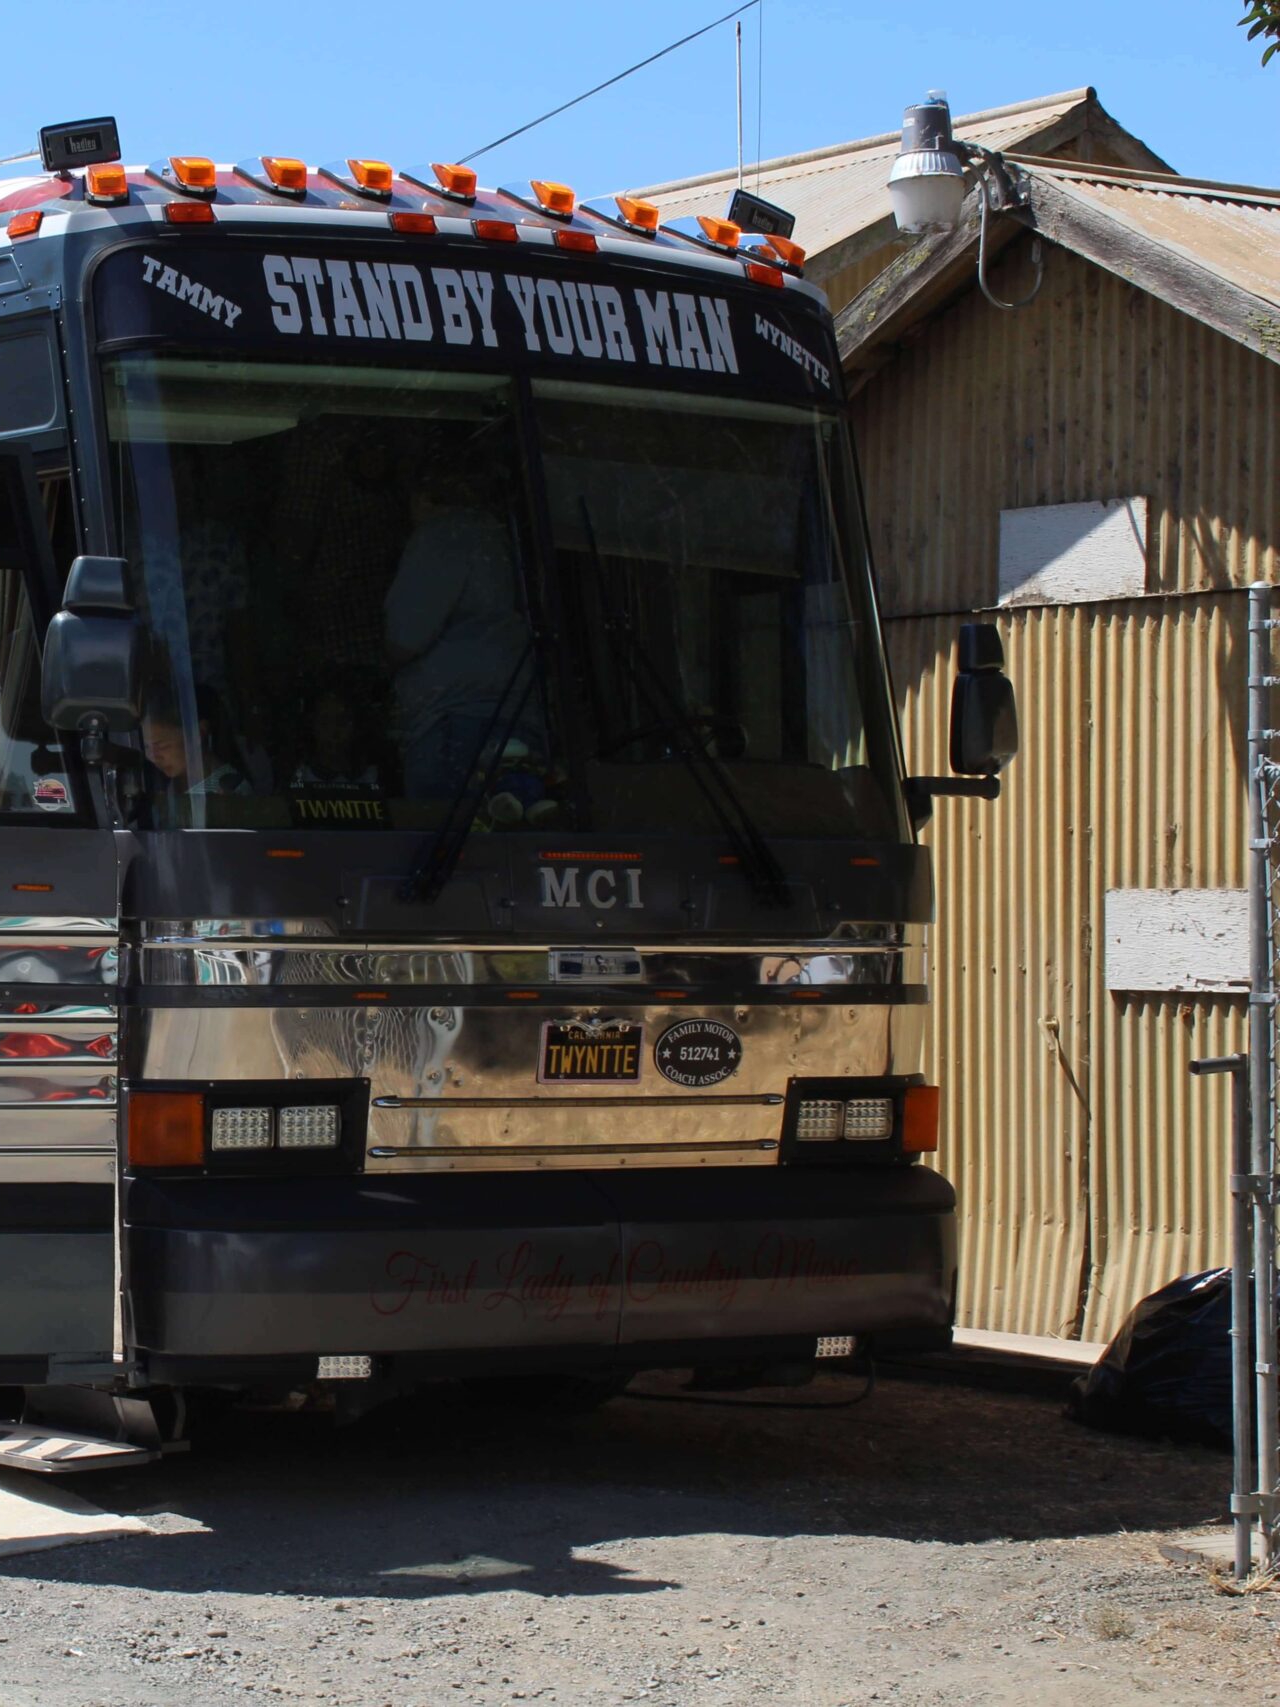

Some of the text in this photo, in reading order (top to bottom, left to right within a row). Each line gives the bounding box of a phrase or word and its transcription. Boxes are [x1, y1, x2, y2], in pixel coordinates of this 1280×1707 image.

[141, 255, 243, 329] TAMMY
[262, 254, 739, 374] STAND BY YOUR MAN
[754, 313, 832, 388] WYNETTE
[295, 799, 384, 820] TWYNTTE
[539, 866, 644, 909] MCI
[668, 1023, 734, 1044] FAMILY MOTOR
[549, 1045, 636, 1074] TWYNTTE
[679, 1047, 720, 1061] 512741
[665, 1065, 696, 1084] COACH
[370, 1231, 861, 1322] First Lady of Country Music
